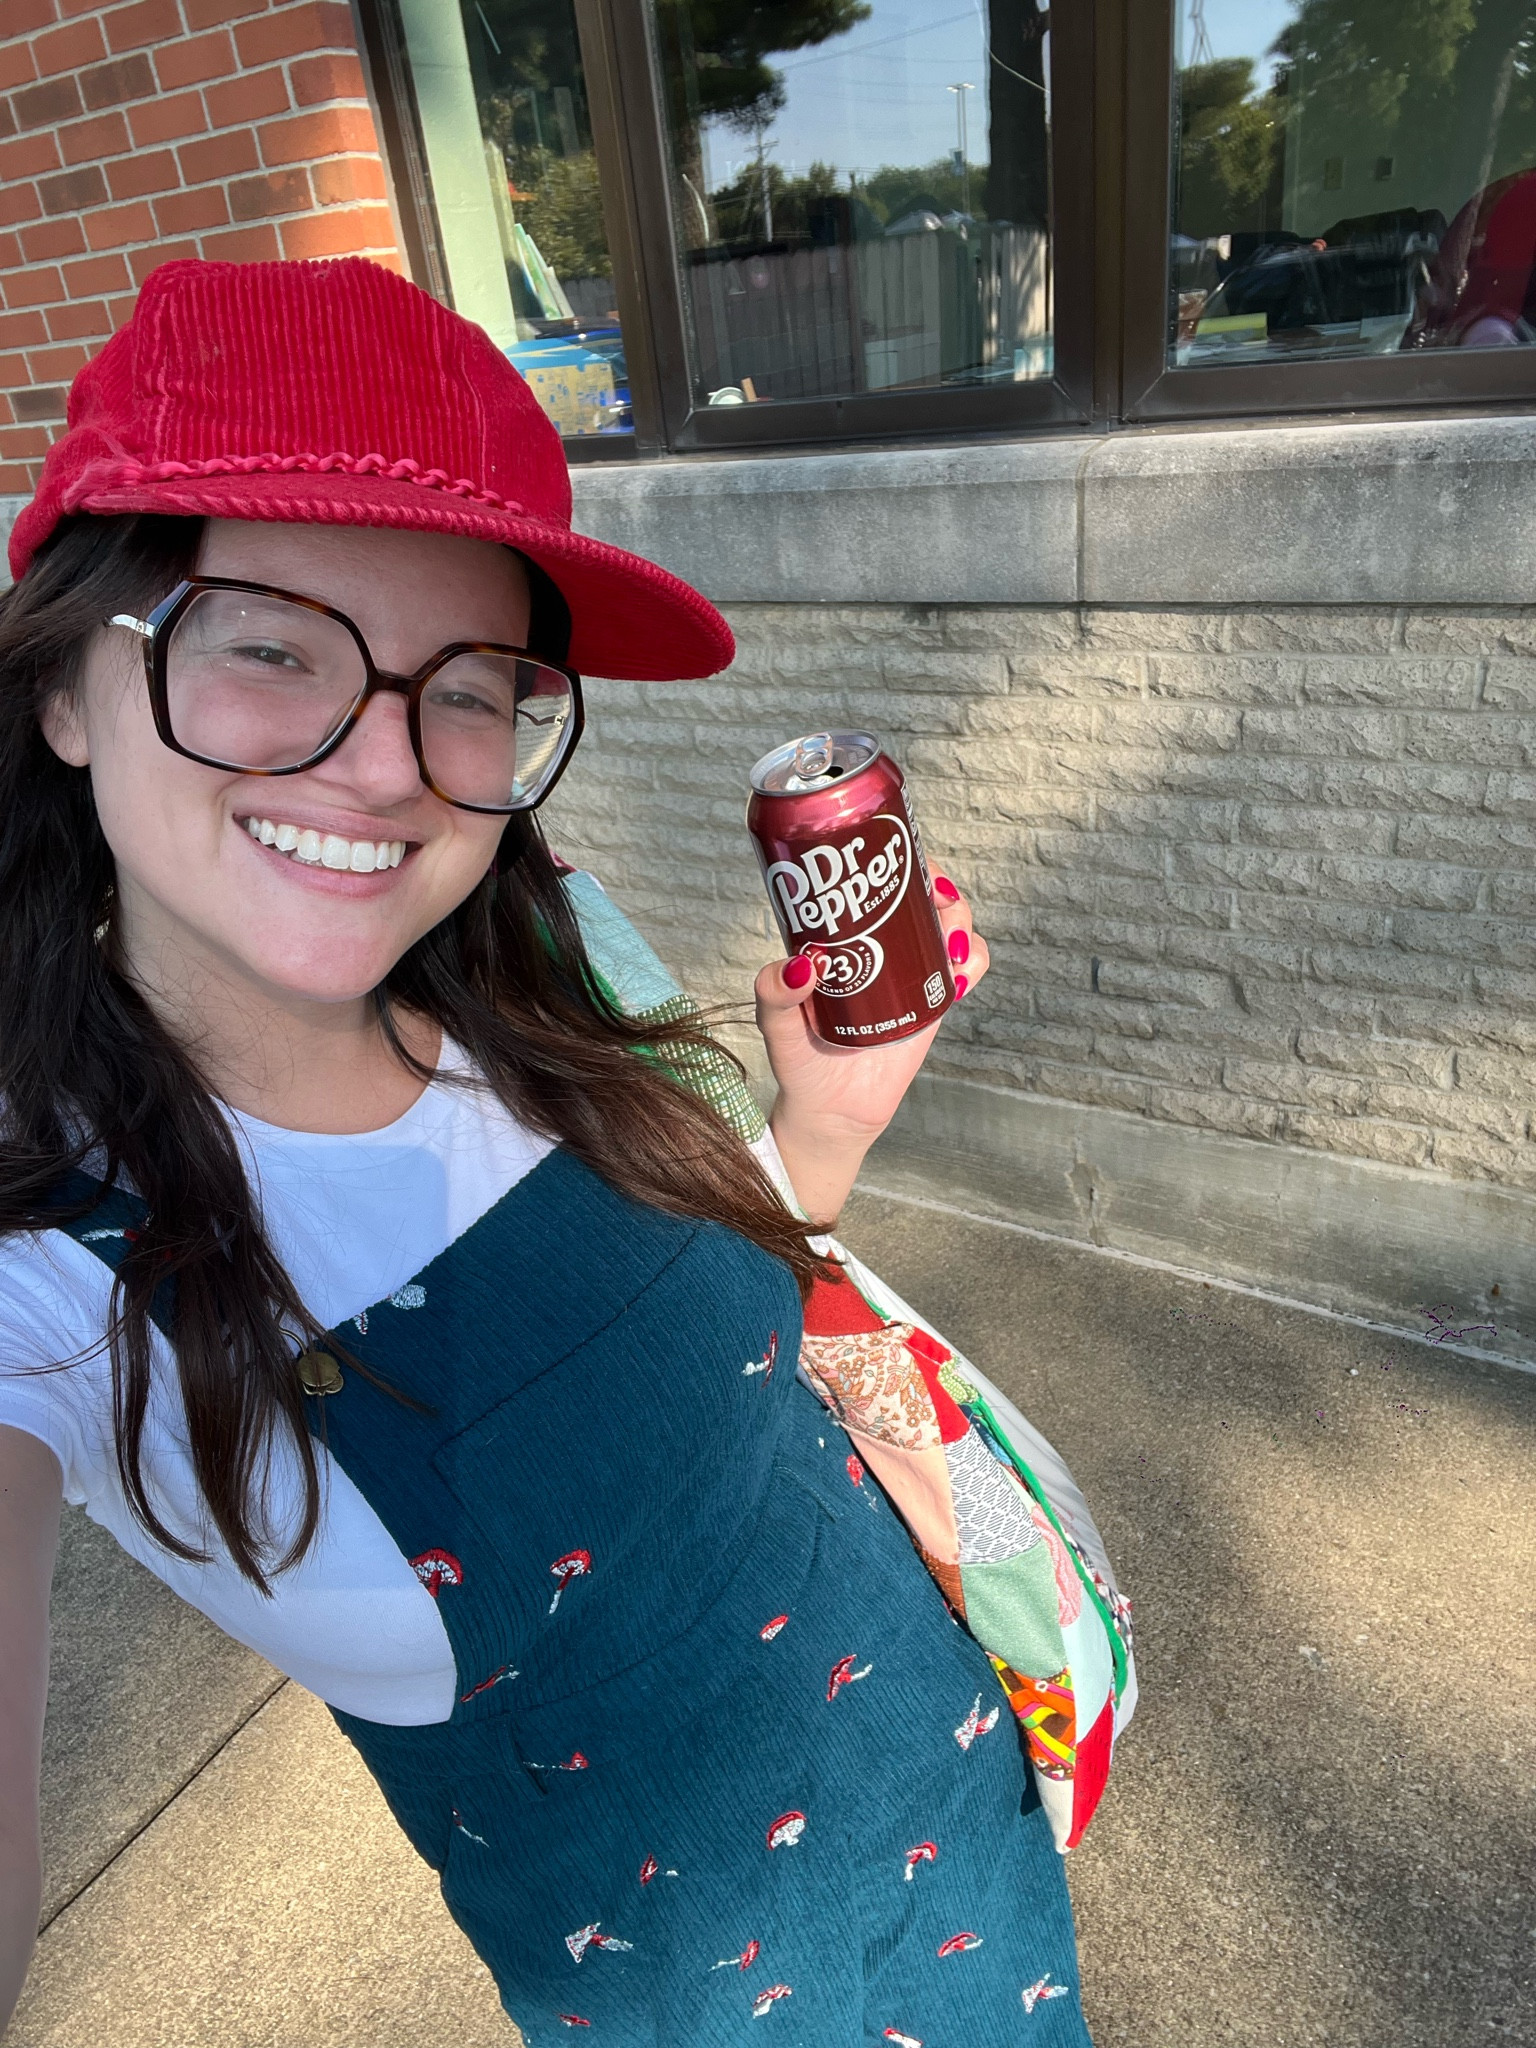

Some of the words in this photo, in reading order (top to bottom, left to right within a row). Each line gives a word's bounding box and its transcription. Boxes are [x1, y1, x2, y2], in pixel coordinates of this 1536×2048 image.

[800, 837, 865, 896] Dr
[767, 833, 902, 936] Pepper
[816, 954, 853, 982] 23
[822, 986, 844, 994] BLEND
[860, 952, 872, 980] FLAVORS
[926, 974, 942, 995] 150
[834, 1026, 846, 1035] 12
[846, 1026, 859, 1035] FL
[860, 1025, 874, 1035] OZ
[875, 1019, 897, 1034] (355
[898, 1011, 917, 1025] mL)
